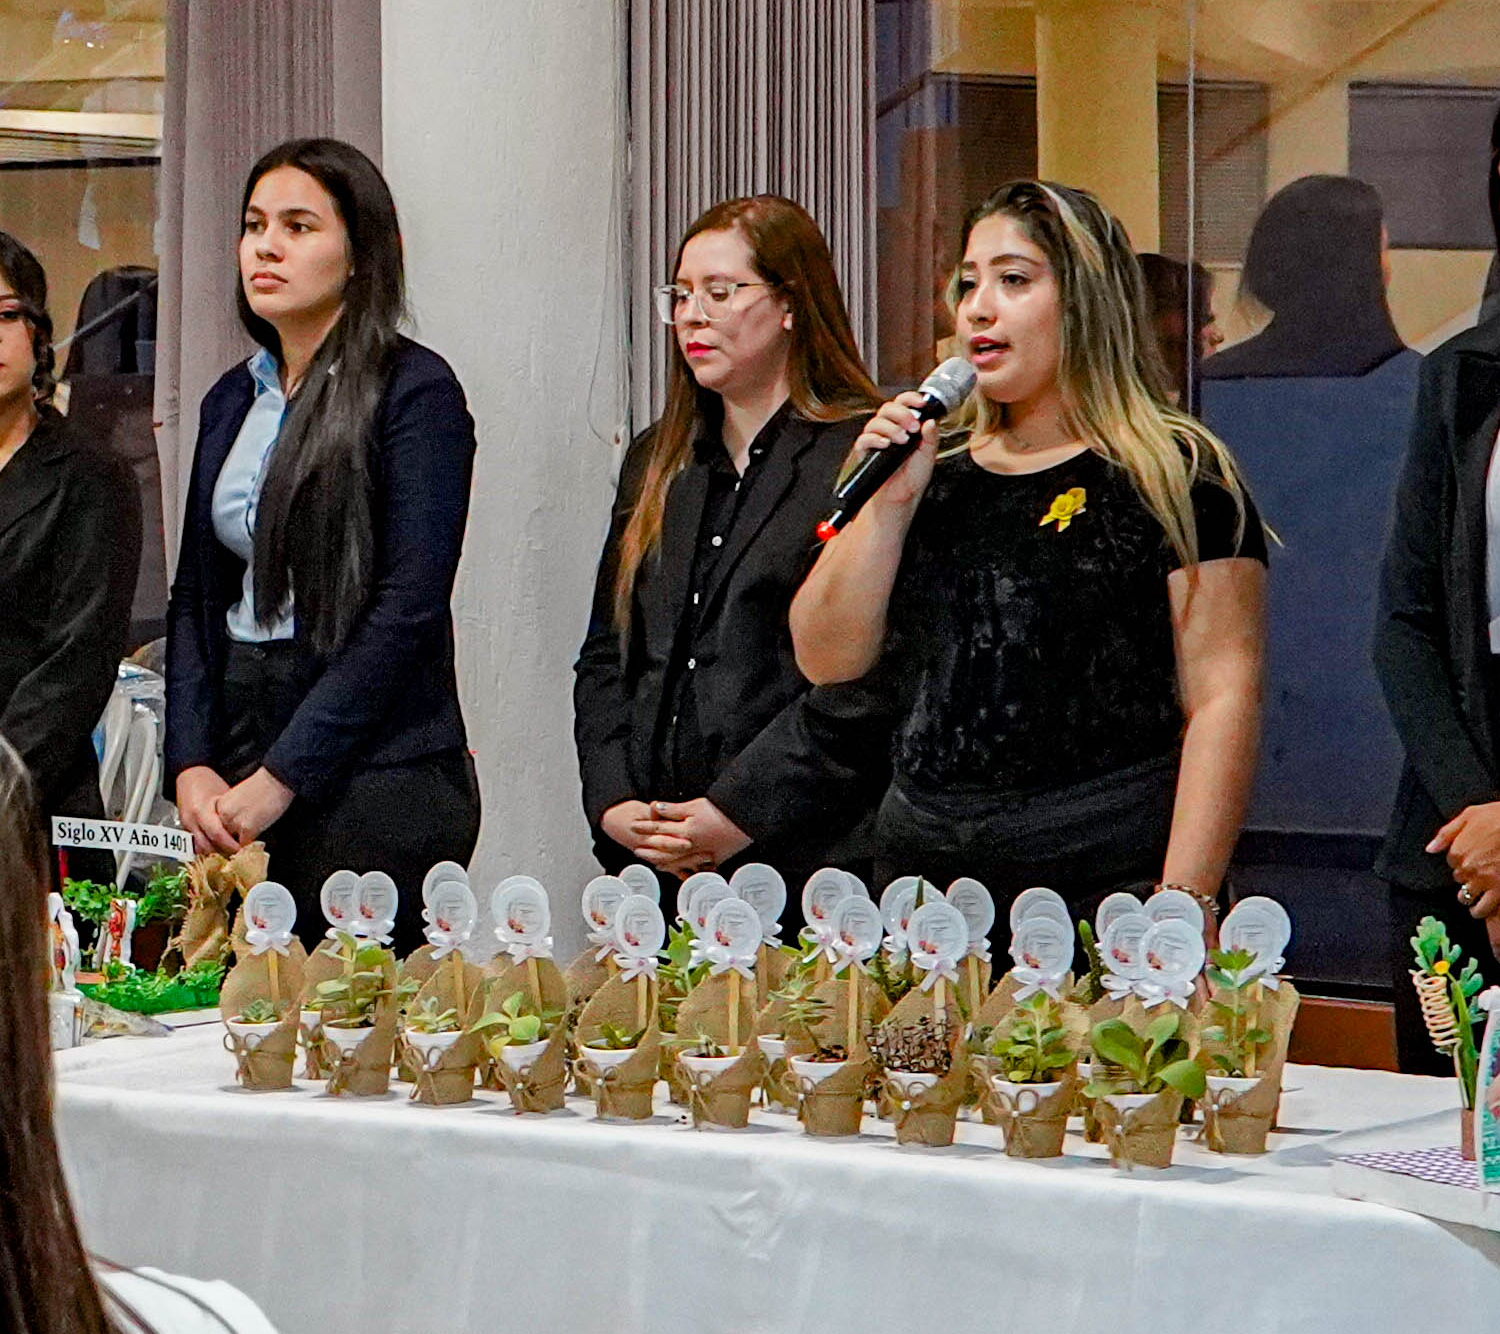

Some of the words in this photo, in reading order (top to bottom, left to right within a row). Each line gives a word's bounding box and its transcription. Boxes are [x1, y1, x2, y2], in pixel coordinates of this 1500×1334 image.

[57, 821, 95, 844] Siglo
[100, 825, 125, 843] XV
[129, 829, 159, 847] Año
[163, 832, 188, 854] 1401
